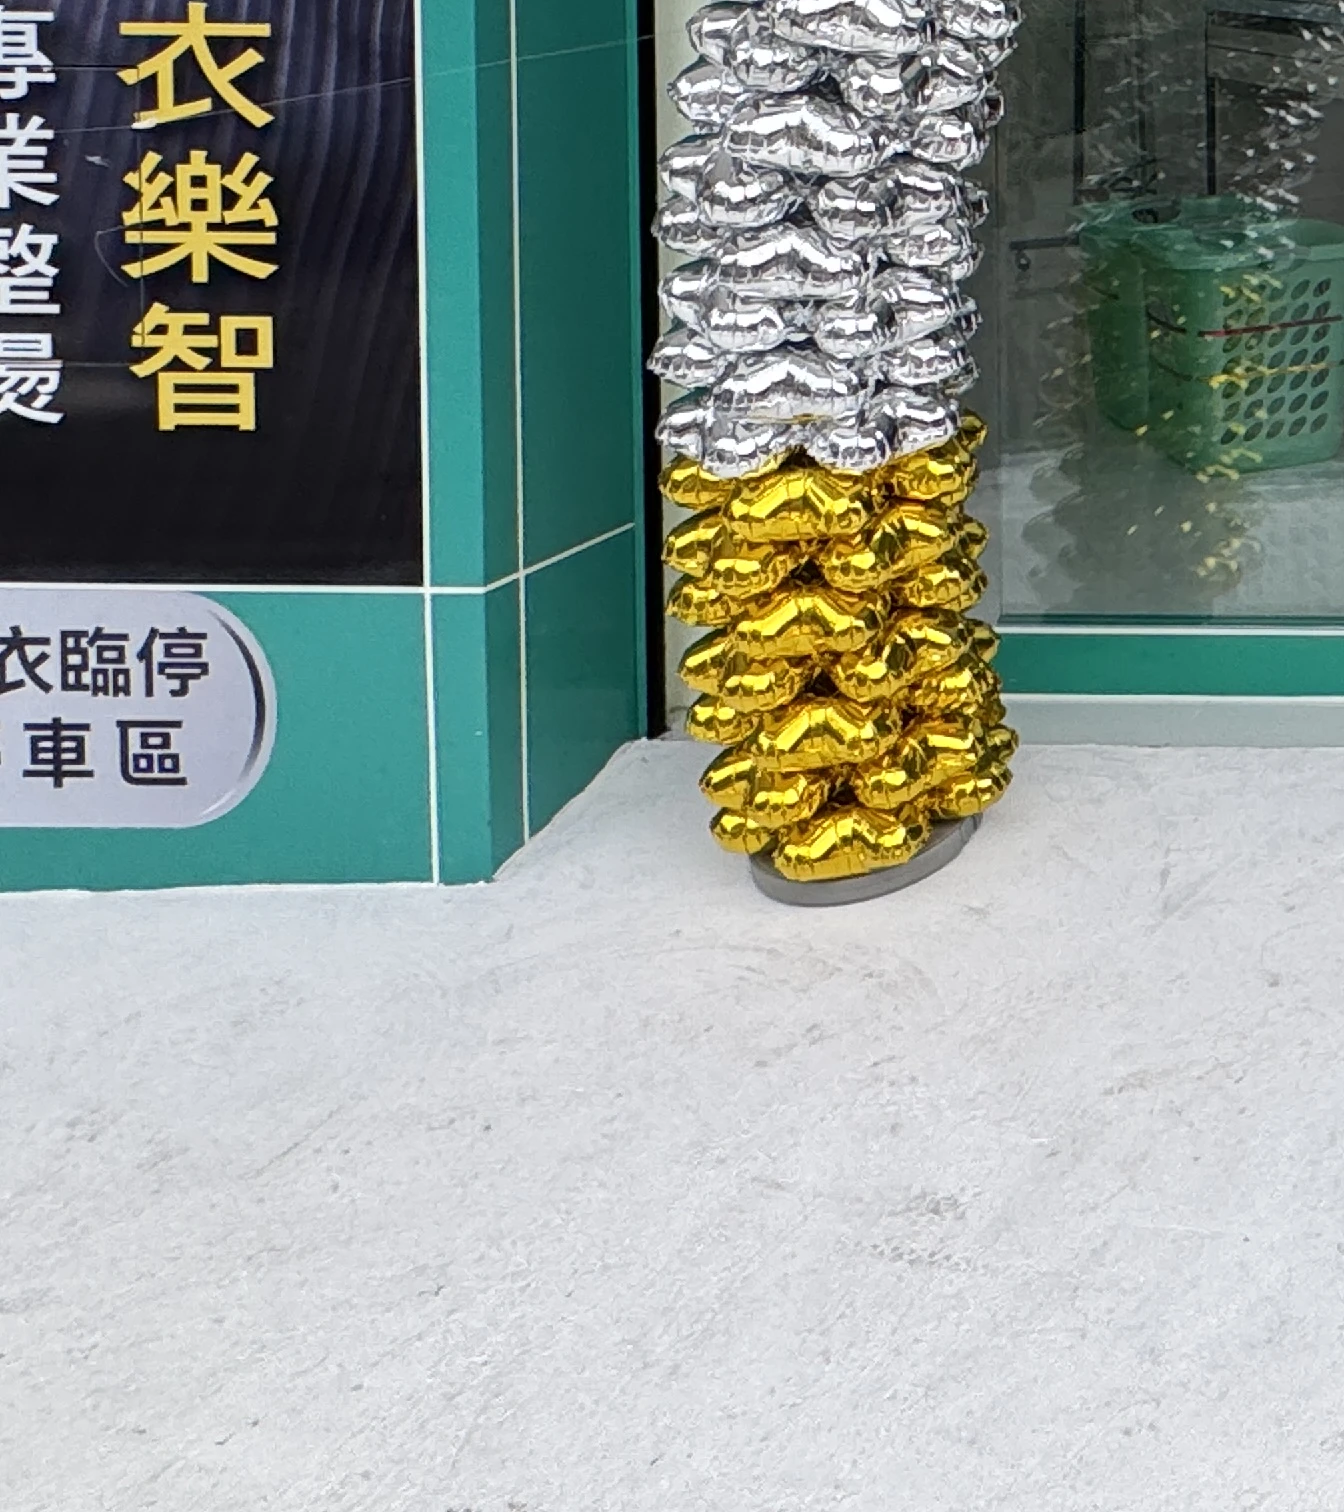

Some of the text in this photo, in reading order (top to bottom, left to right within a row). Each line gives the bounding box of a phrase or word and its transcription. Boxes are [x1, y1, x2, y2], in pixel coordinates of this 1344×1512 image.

[116, 0, 280, 432] 衣樂智
[0, 624, 209, 697] 衣臨停
